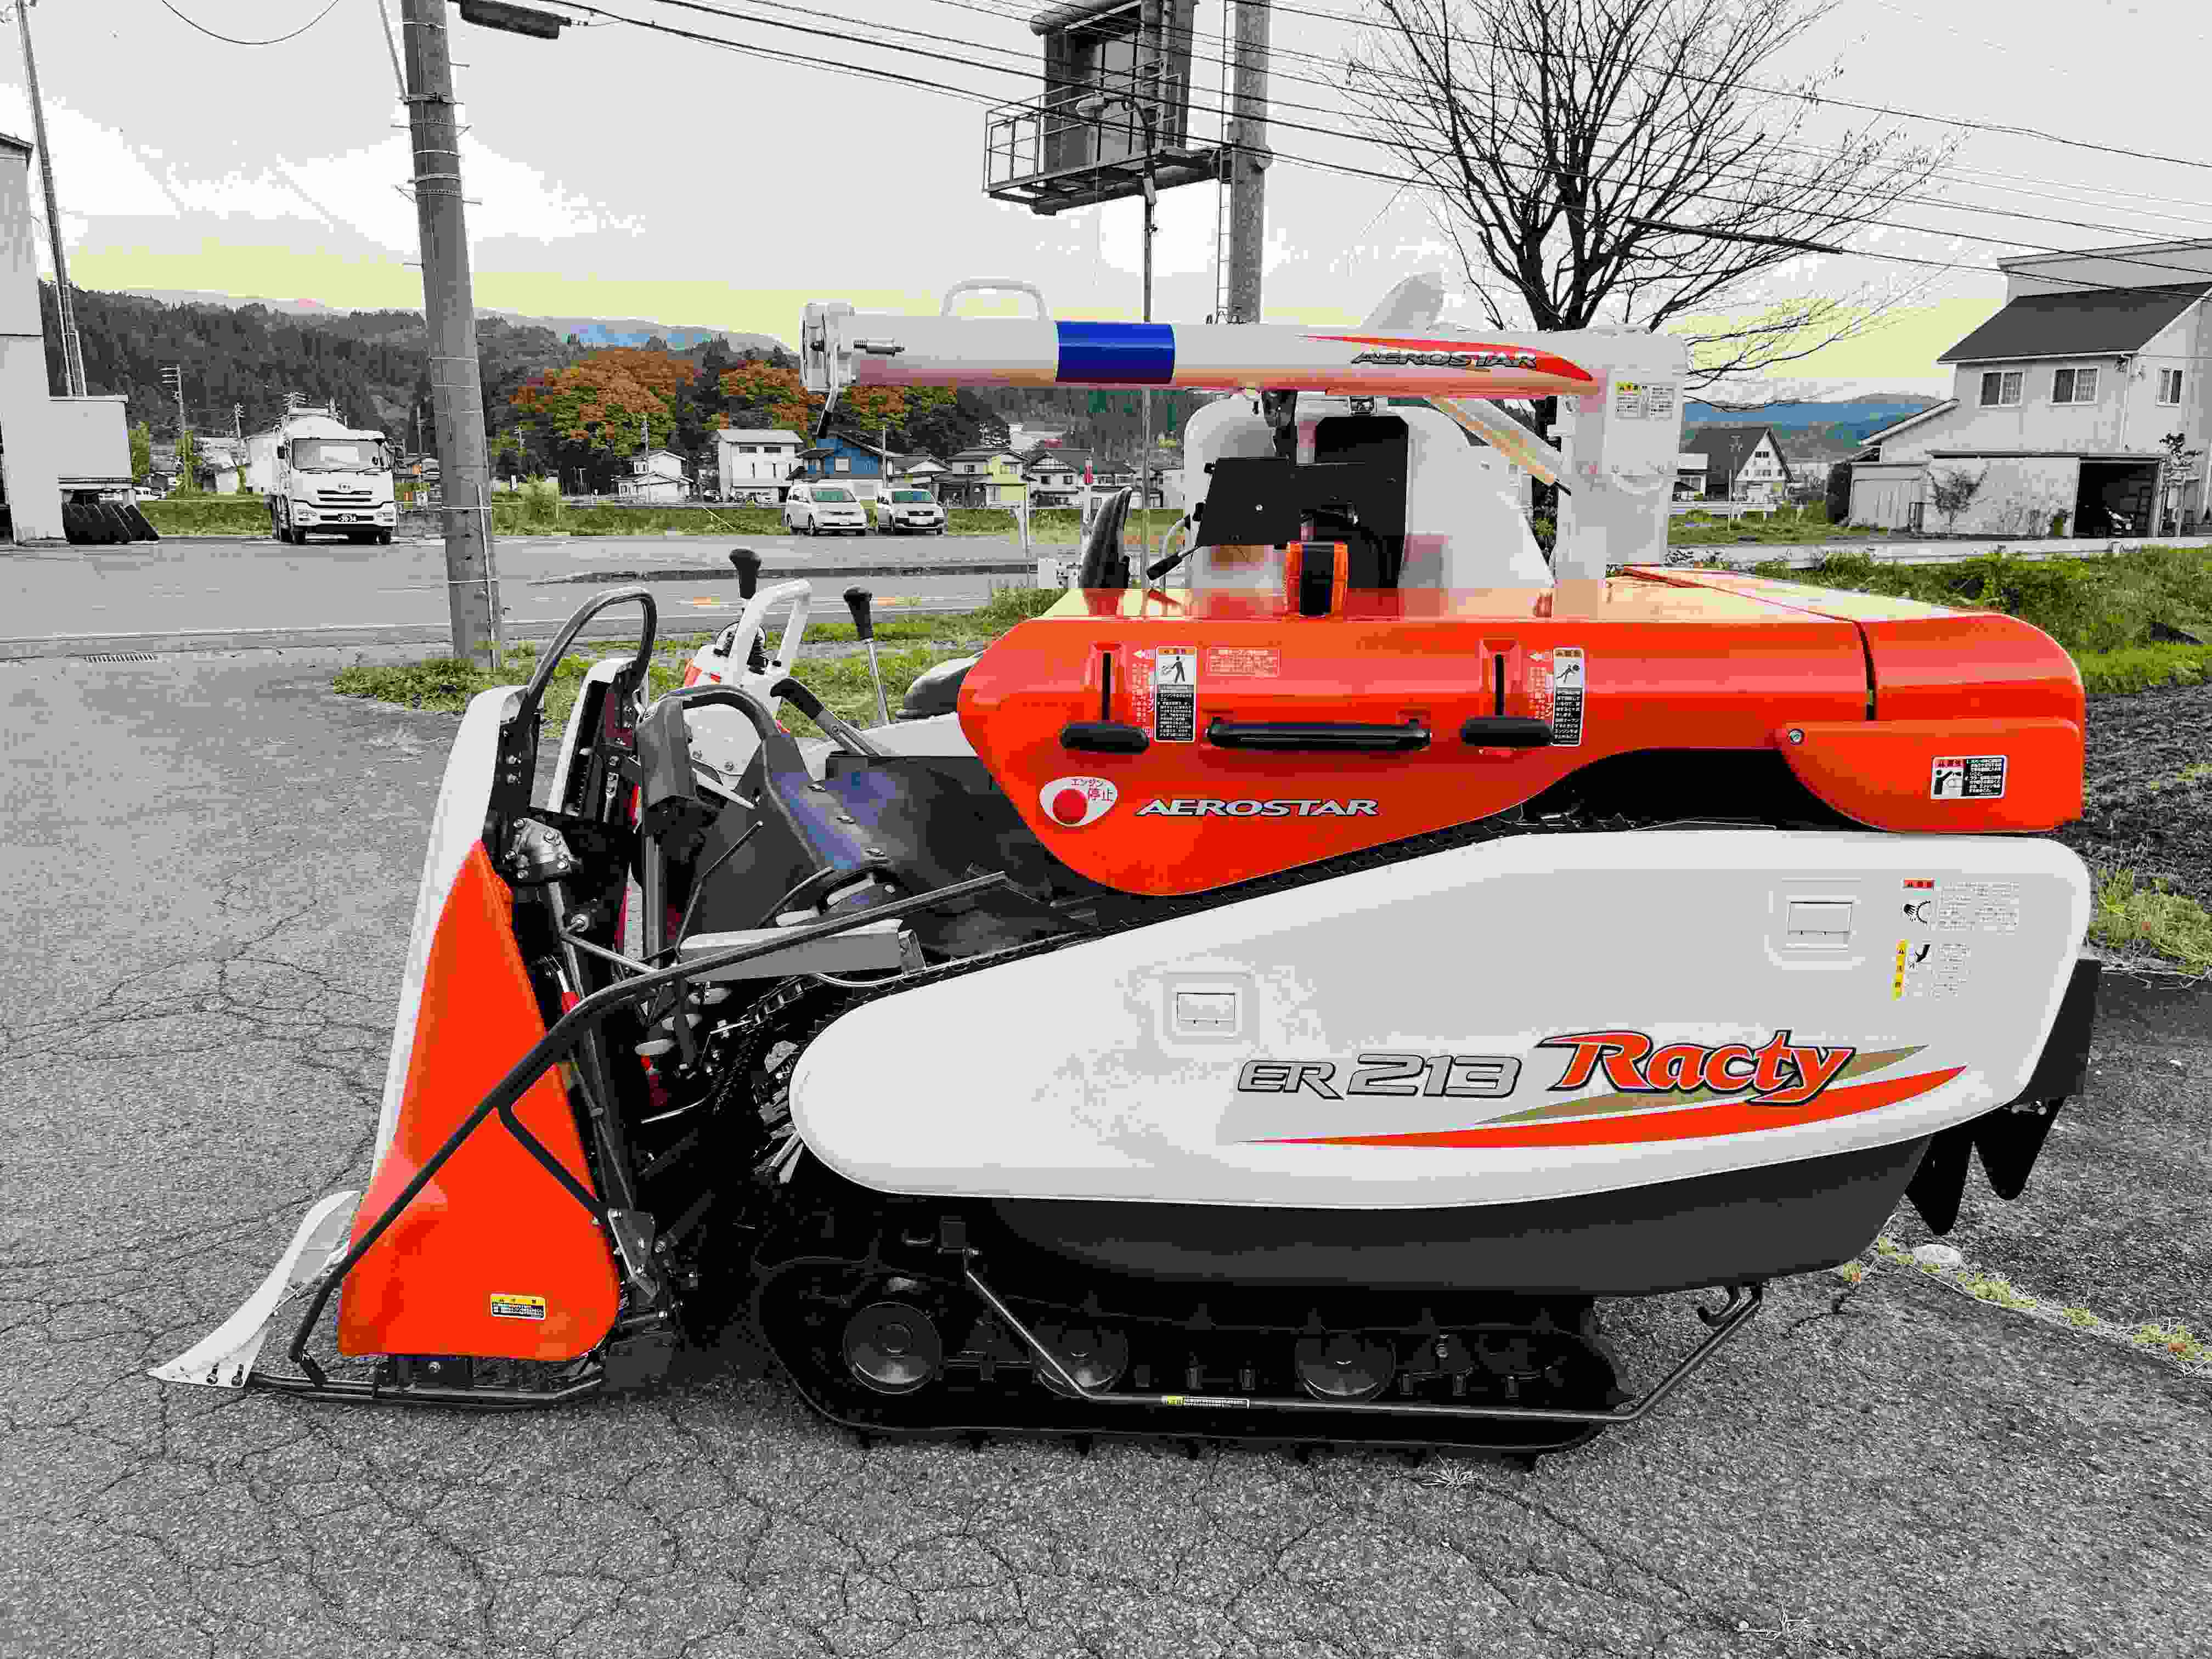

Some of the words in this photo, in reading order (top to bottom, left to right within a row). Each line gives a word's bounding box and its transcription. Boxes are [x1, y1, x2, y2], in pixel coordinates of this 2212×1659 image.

[1351, 351, 1537, 369] AEROSTAR
[1070, 778, 1103, 787] エンジン
[1088, 787, 1116, 803] 停止
[1134, 799, 1380, 816] AEROSTAR
[1238, 1059, 1345, 1101] ER
[1347, 1053, 1523, 1098] 213
[1536, 1029, 1857, 1106] Racty
